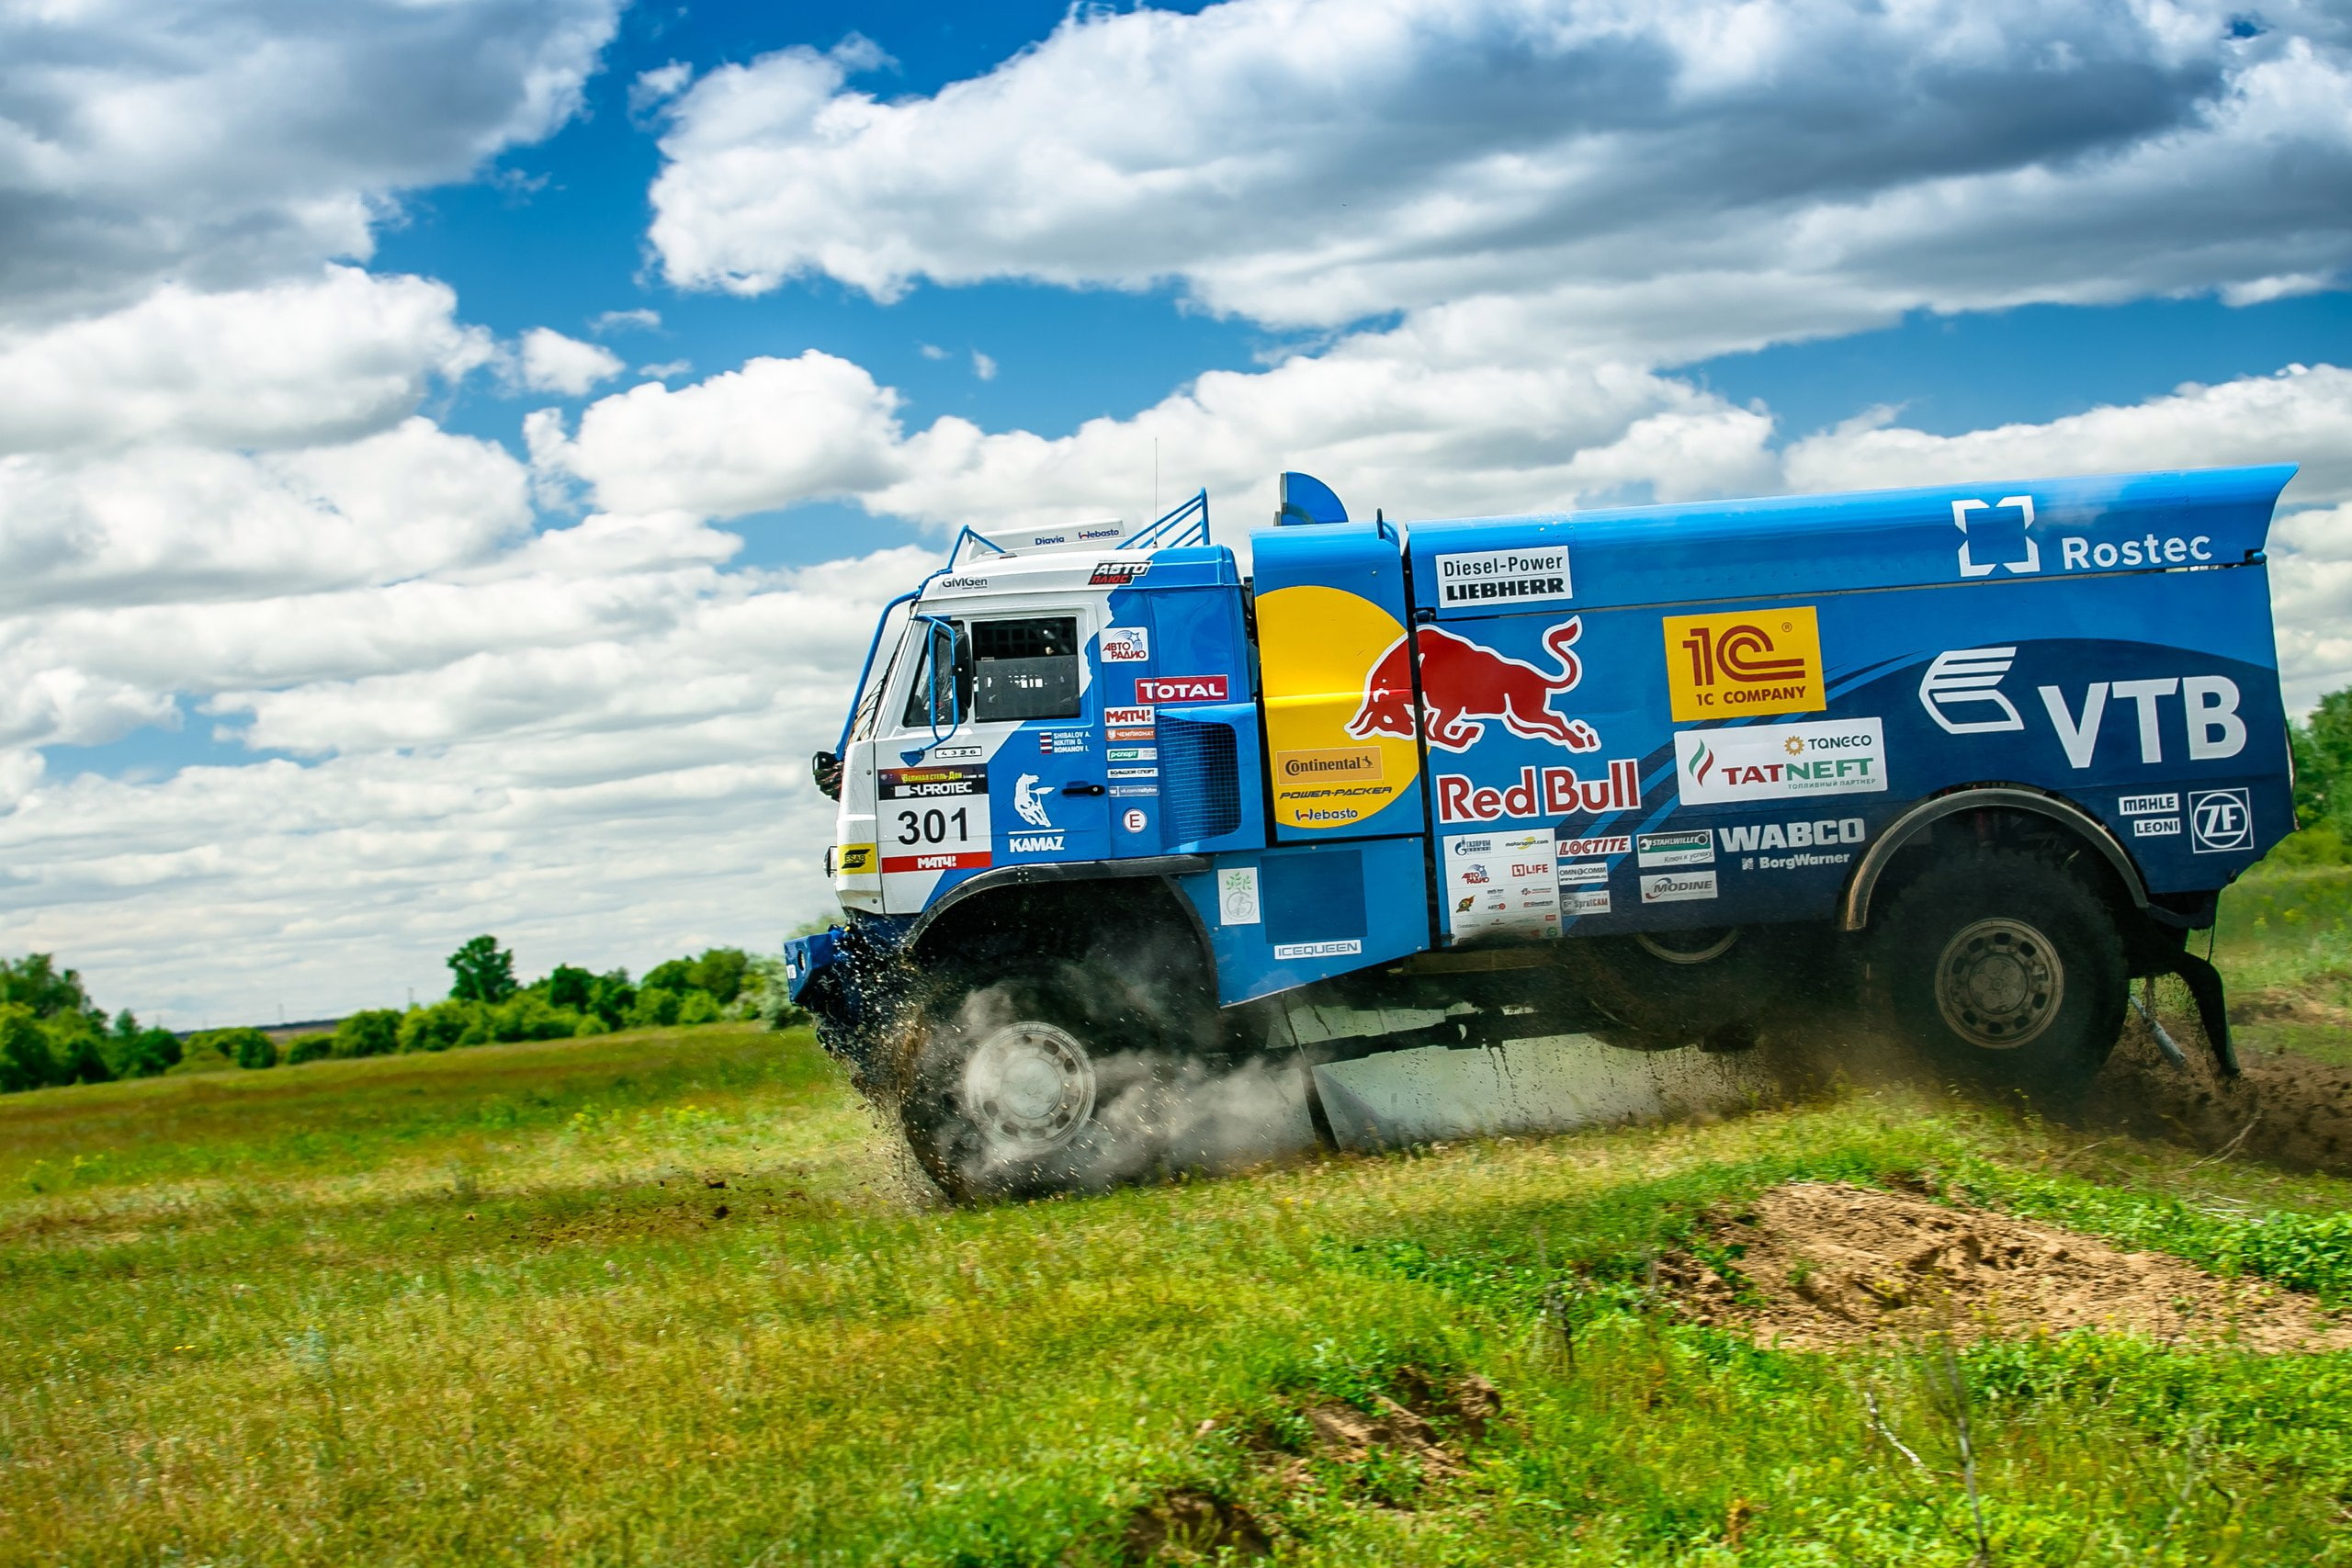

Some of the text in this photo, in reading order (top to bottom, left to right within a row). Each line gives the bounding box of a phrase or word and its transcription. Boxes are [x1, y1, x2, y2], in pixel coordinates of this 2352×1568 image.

[1035, 536, 1065, 546] Diavia
[1078, 528, 1120, 540] Webasto
[2062, 534, 2212, 570] Rostec
[1094, 563, 1148, 575] АВТО
[1443, 555, 1564, 578] Diesel-Power
[1091, 575, 1129, 584] ПЛЮС
[1446, 578, 1566, 601] LIEBHERR
[1102, 642, 1131, 652] АВТО
[1111, 649, 1147, 660] РАДИО
[1139, 682, 1225, 700] TOTAL
[1696, 686, 1806, 706] 1C COMPANY
[2037, 675, 2247, 770] VTB
[1808, 735, 1872, 750] TANECO
[1284, 756, 1362, 776] Continental
[1721, 757, 1874, 785] TATNEFT
[1438, 761, 1640, 822] Red Bull
[1788, 778, 1876, 790] ТОПЛИВНЫЙ ПАРТНЕР
[1279, 786, 1393, 800] POWER-PACKER
[2123, 796, 2175, 812] MAHLE
[1129, 814, 1141, 829] E
[1295, 808, 1358, 821] Webasto
[898, 807, 968, 846] 301
[2136, 820, 2178, 834] LEONI
[1718, 818, 1866, 852] WABCO
[1009, 836, 1065, 853] KAMAZ
[1559, 837, 1629, 856] LOCTITE
[1758, 853, 1850, 870] BorgWarner
[1654, 879, 1713, 894] MODINE
[1278, 942, 1359, 957] ICEQUEEN
